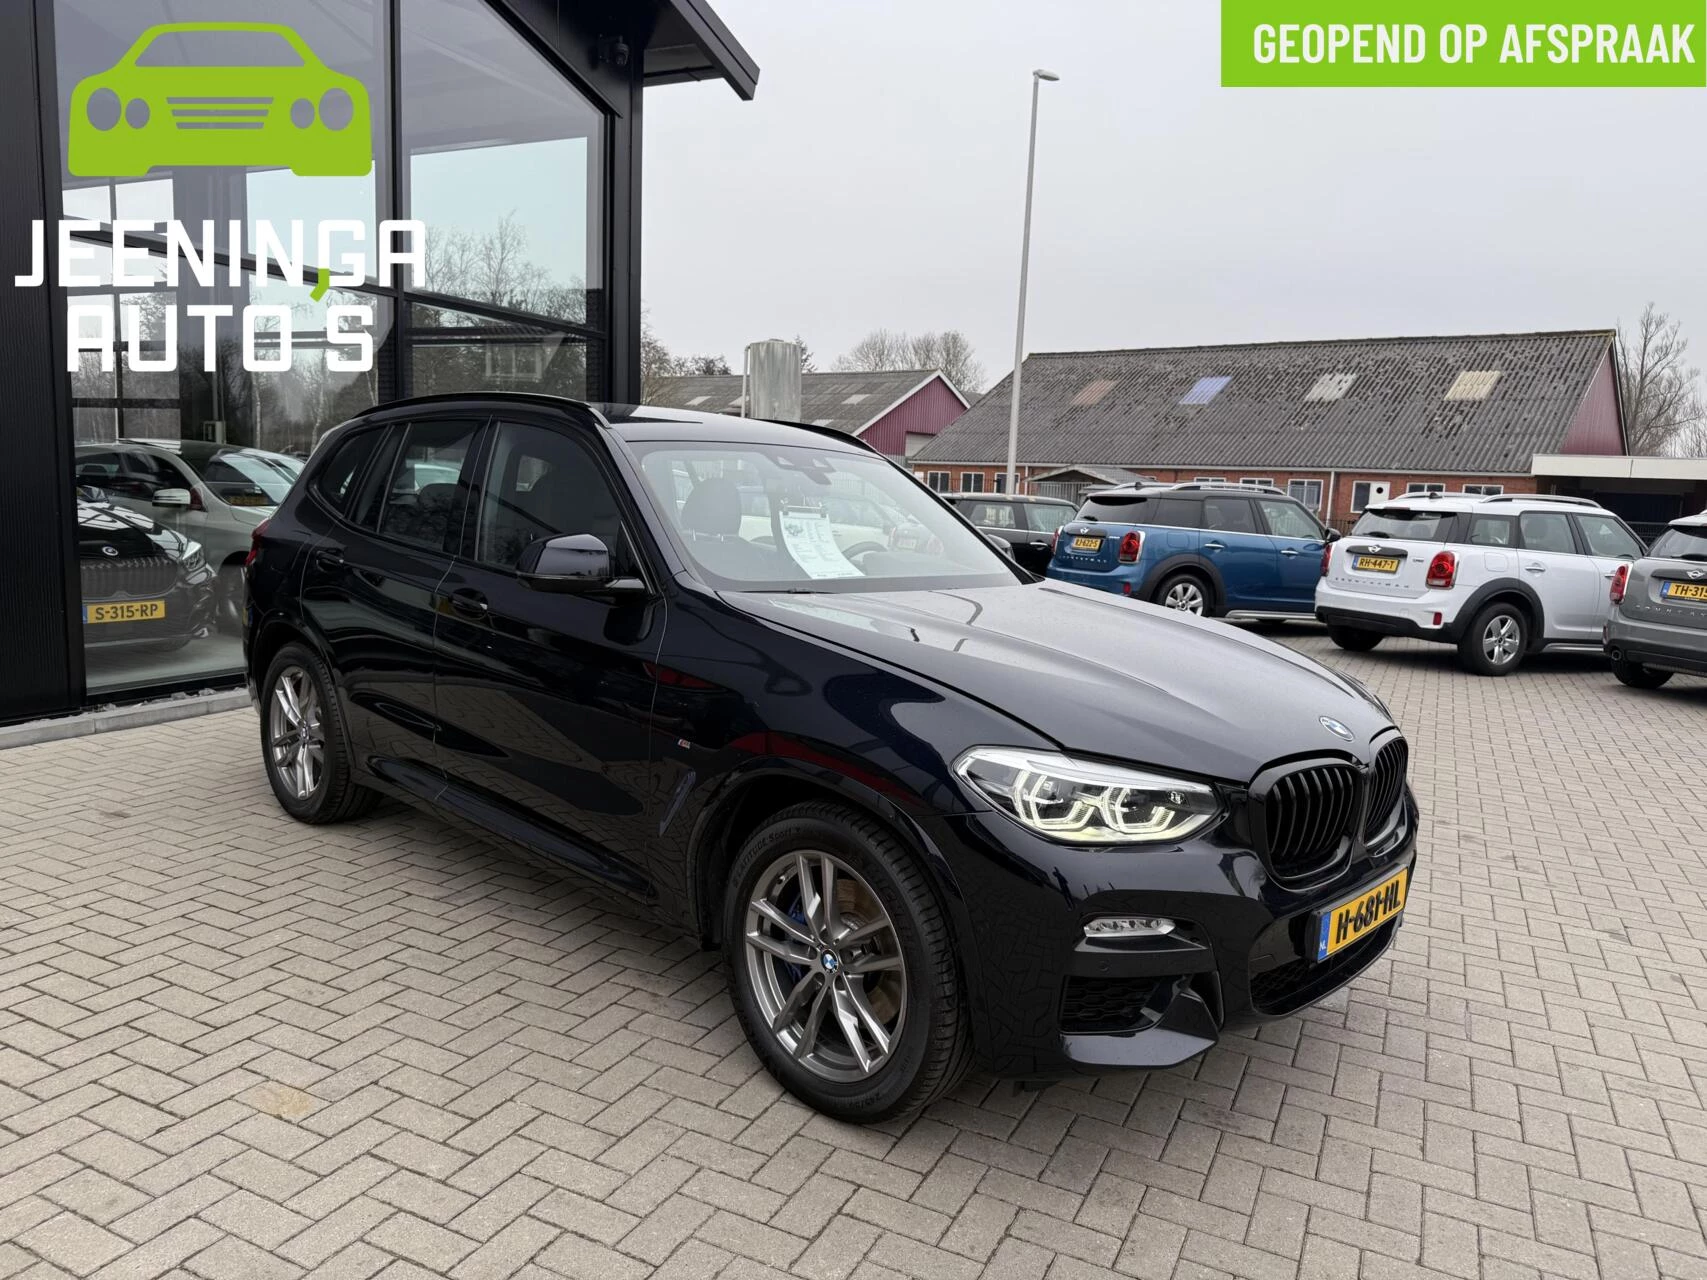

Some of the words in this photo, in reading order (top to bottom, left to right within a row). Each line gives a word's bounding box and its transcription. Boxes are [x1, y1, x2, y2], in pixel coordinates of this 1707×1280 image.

[1358, 556, 1396, 569] RH-447-T
[95, 603, 159, 621] S-315-RP
[1335, 880, 1401, 944] H-681-HL
